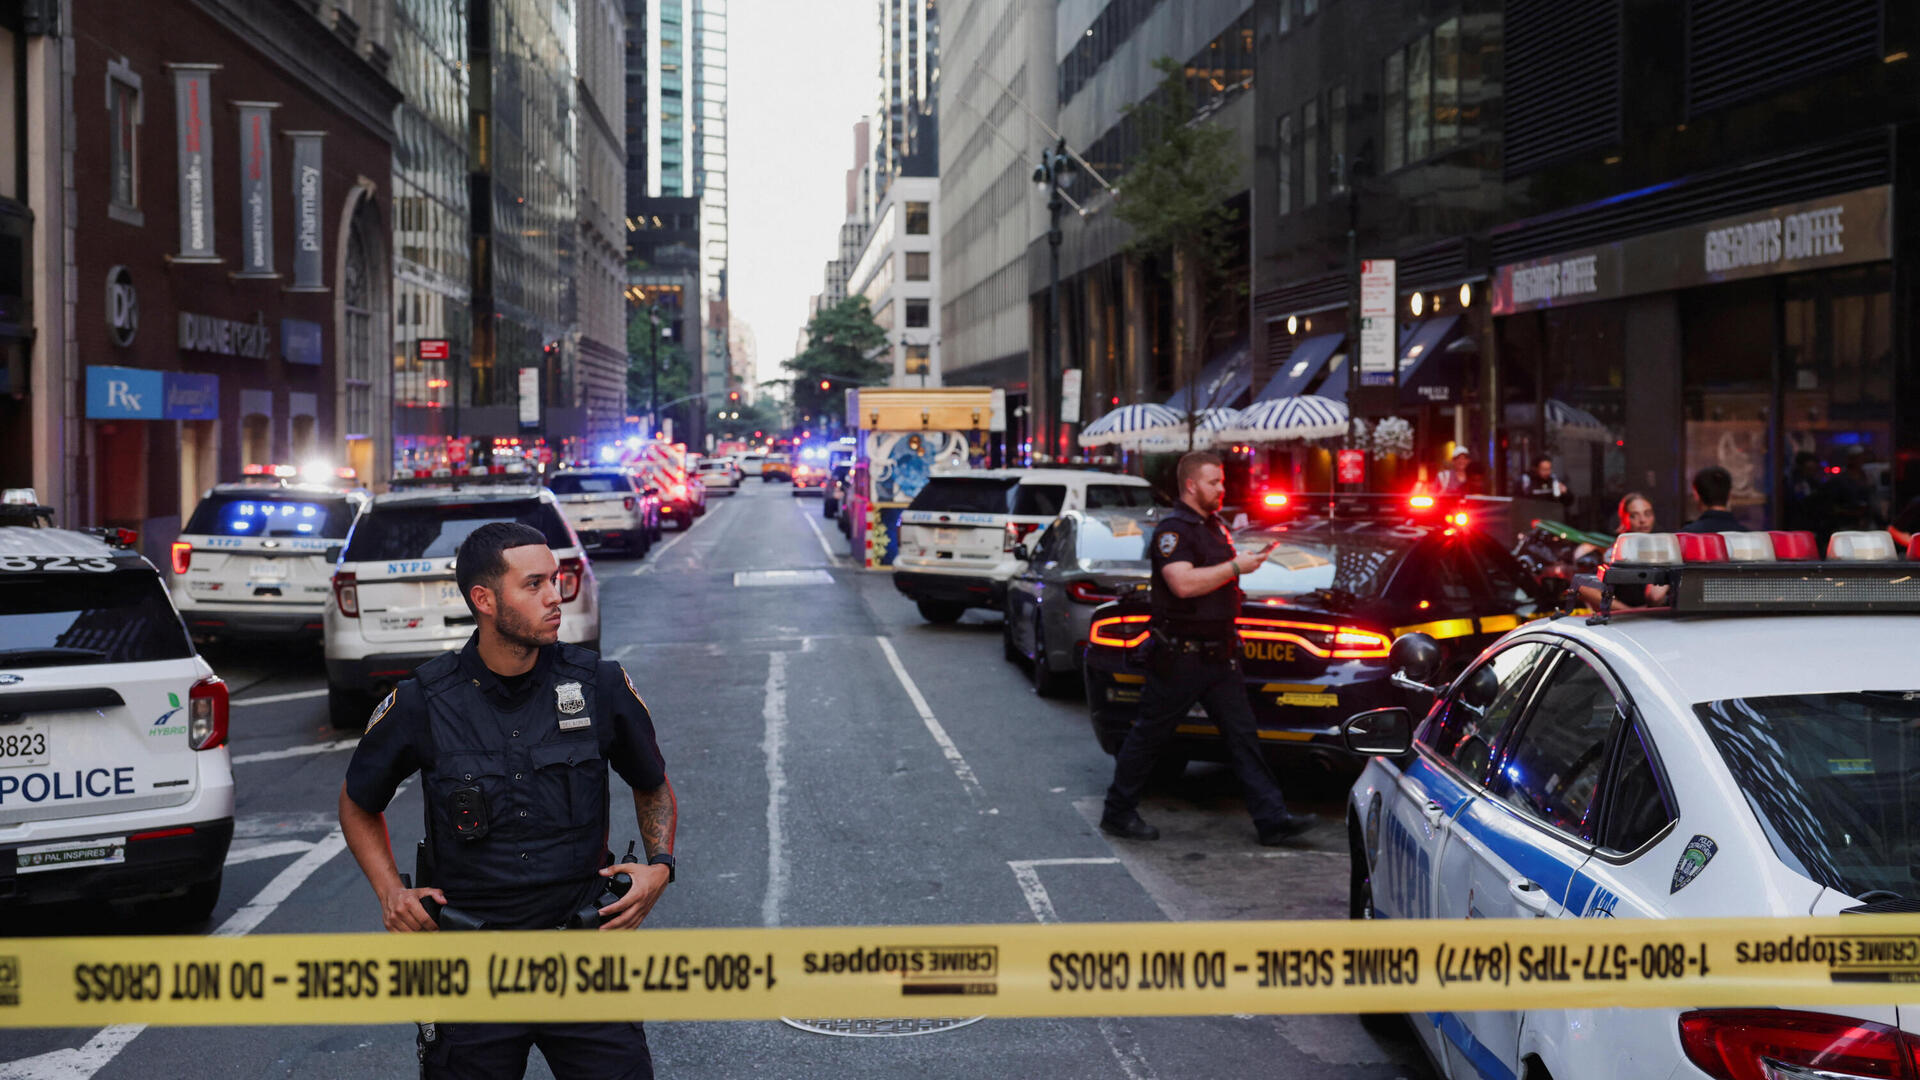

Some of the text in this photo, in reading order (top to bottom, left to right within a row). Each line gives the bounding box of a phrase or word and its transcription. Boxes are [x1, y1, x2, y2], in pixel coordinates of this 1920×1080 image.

[300, 165, 320, 250] pharmacy
[1784, 206, 1844, 260] COFFEE
[240, 504, 316, 518] NYPD
[388, 561, 432, 574] NYPD
[1244, 641, 1296, 662] OLICE
[149, 726, 187, 736] HYBRID
[0, 767, 135, 804] POLICE
[44, 853, 61, 863] PAL
[63, 848, 106, 861] INSPIRES
[297, 960, 380, 998] SCENE
[389, 958, 469, 997] CRIME
[488, 953, 567, 998] (8477)
[576, 953, 776, 992] 1-800-577-TIPS
[1049, 952, 1130, 991] CROSS
[1138, 951, 1185, 989] NOT
[1194, 951, 1226, 988] DO
[1257, 949, 1334, 987] SCENE
[1343, 947, 1418, 985] CRIME
[1436, 941, 1511, 987] (8477)
[1519, 942, 1710, 980] 1-800-577-TIPS
[75, 963, 162, 1001] CROSS
[170, 962, 220, 1000] NOT
[230, 962, 264, 999] DO
